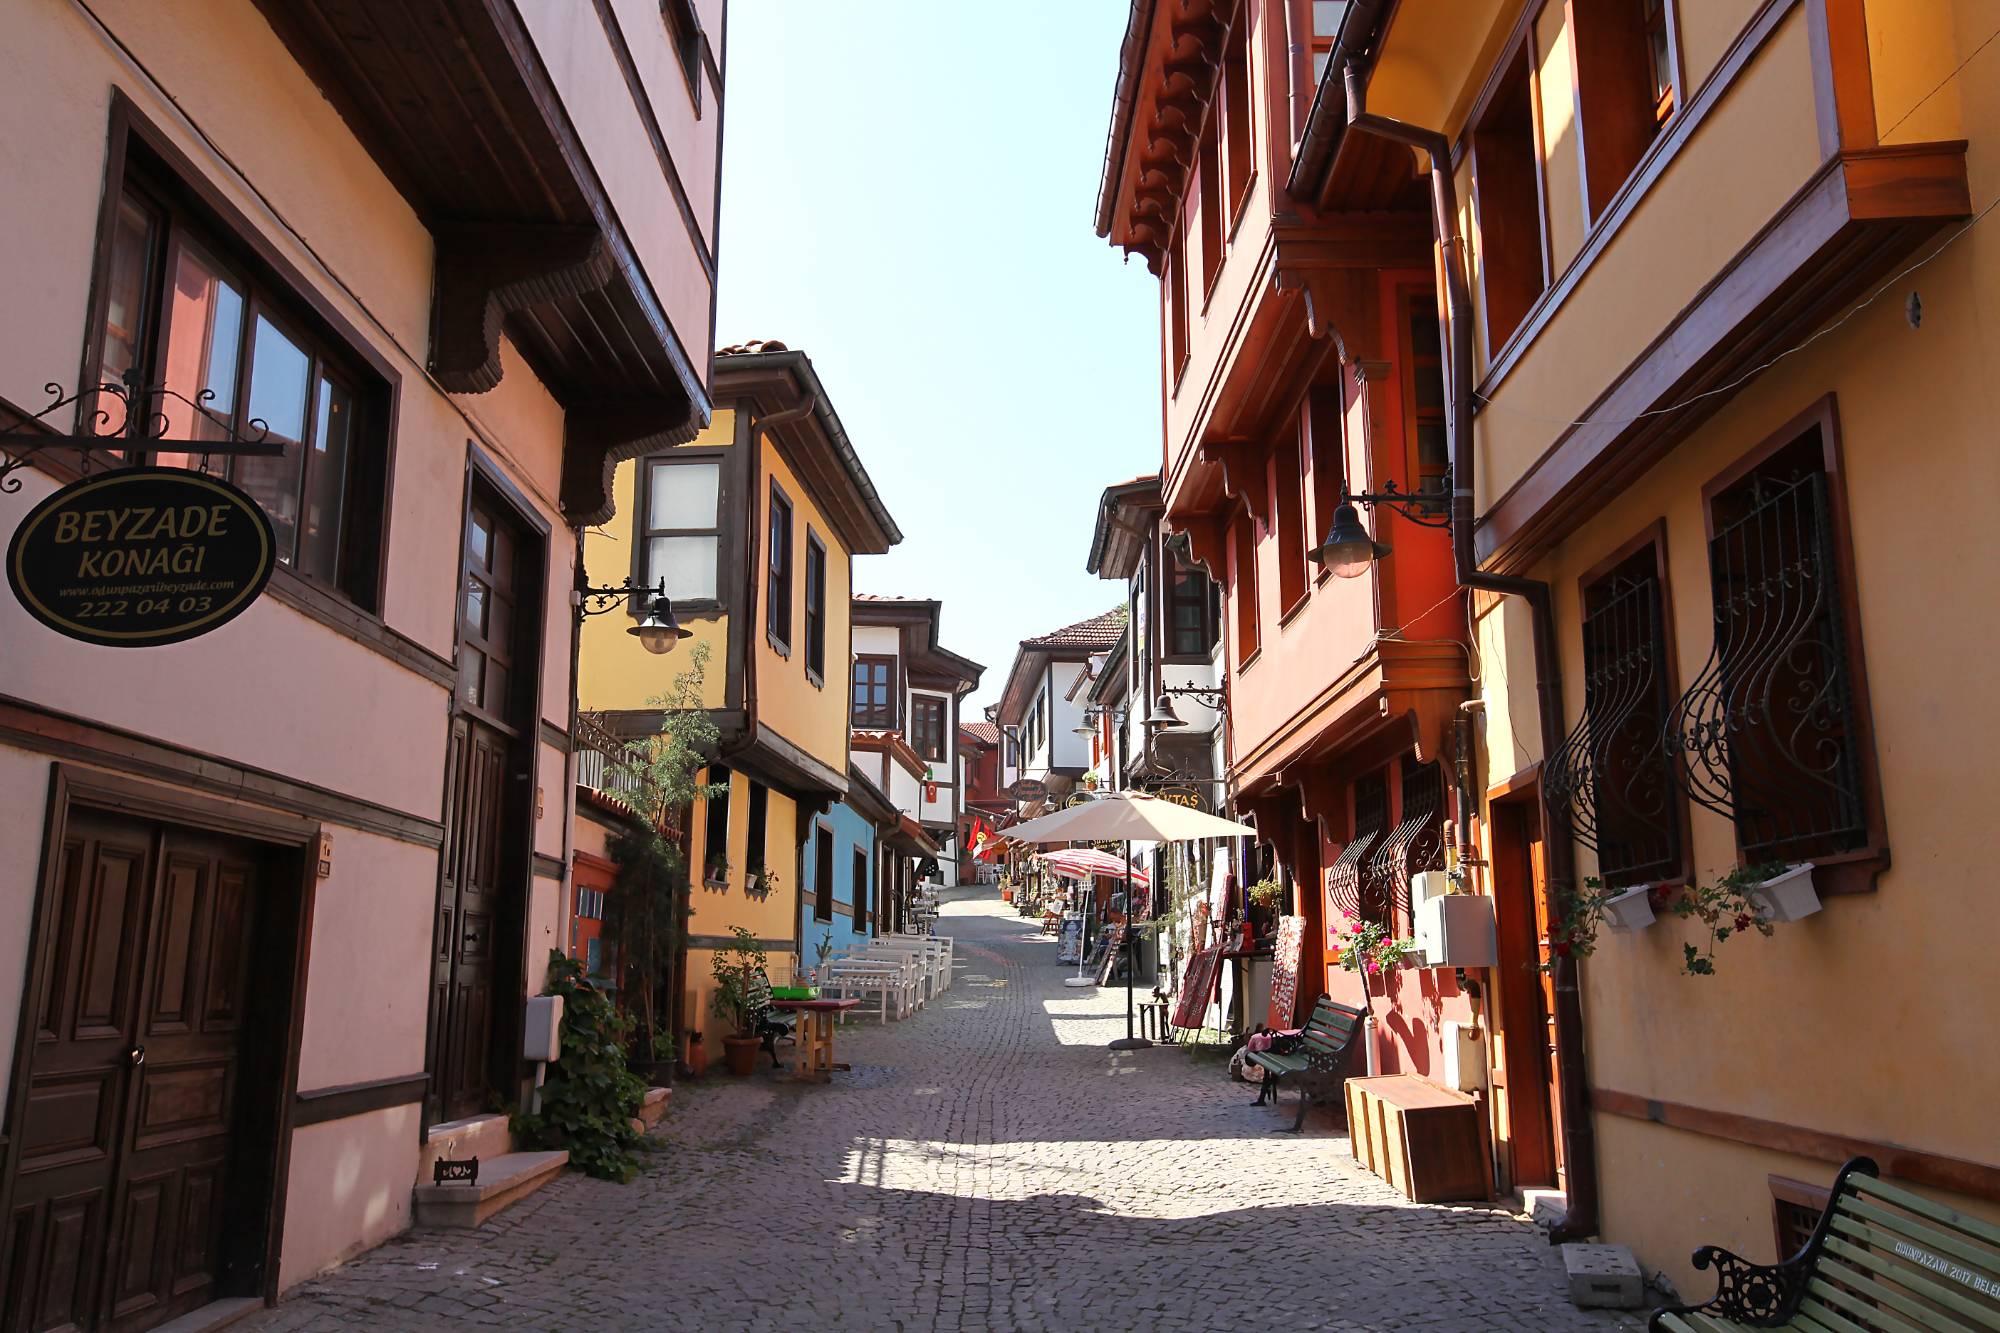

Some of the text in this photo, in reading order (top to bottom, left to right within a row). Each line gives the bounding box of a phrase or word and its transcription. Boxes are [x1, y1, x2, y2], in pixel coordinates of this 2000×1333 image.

[55, 504, 232, 544] BEYZADE
[78, 543, 208, 579] KONAĞI
[77, 597, 211, 617] 222 04 03
[1895, 1241, 1948, 1273] ODUNPAZARI
[1949, 1266, 1971, 1284] 2017
